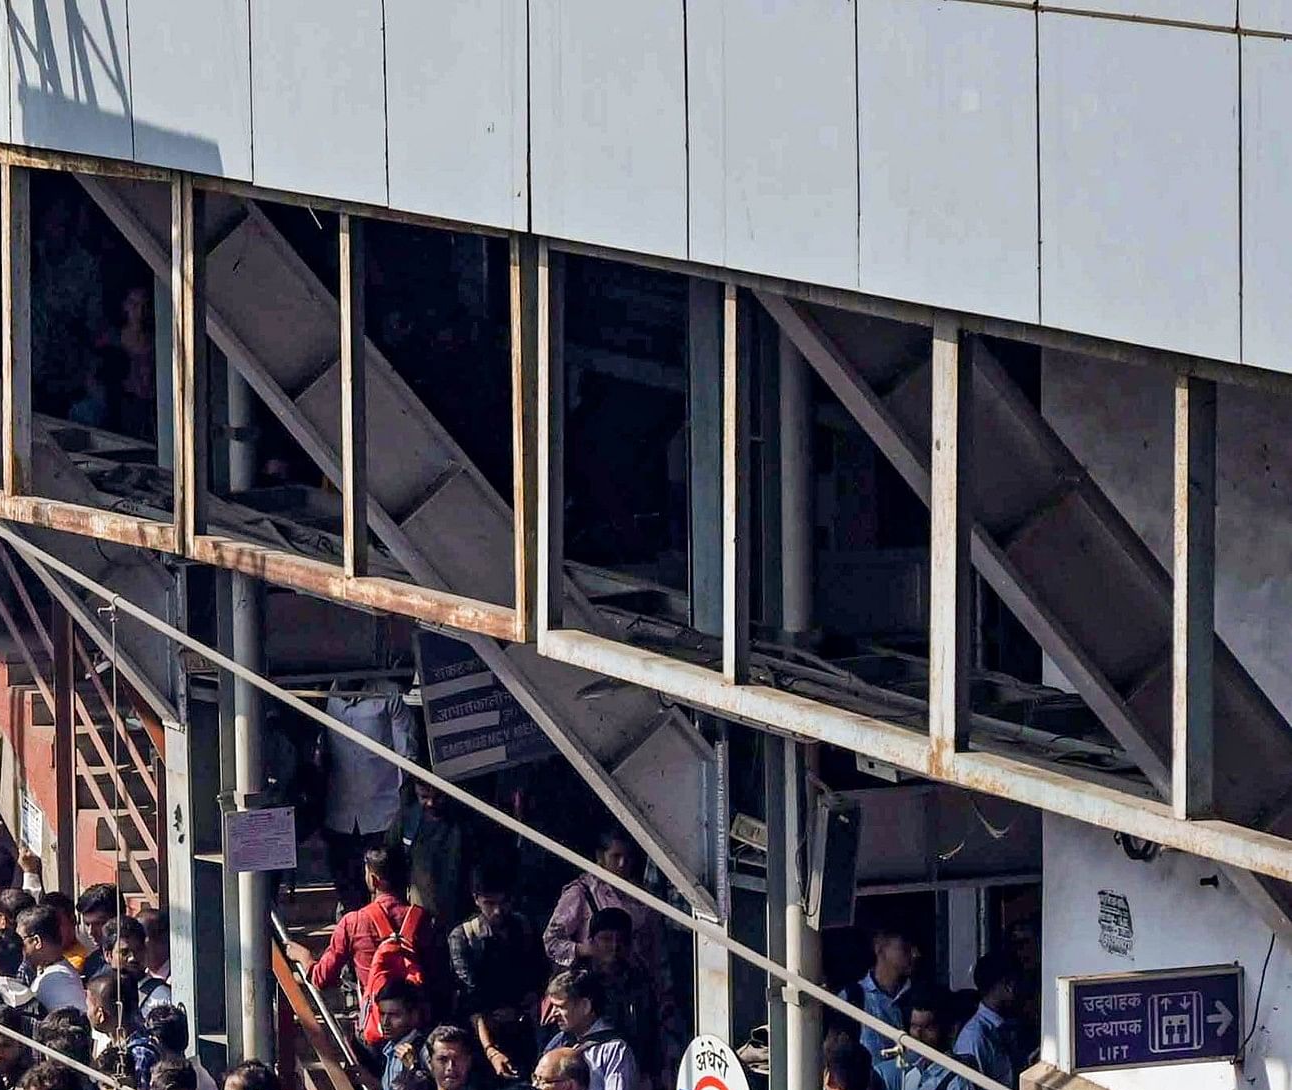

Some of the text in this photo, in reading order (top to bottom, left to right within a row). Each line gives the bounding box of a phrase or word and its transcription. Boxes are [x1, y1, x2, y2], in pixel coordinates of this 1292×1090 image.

[1082, 1019, 1142, 1038] उत्थापक
[696, 1041, 729, 1079] अंधेरी
[1099, 1045, 1129, 1061] LIFT
